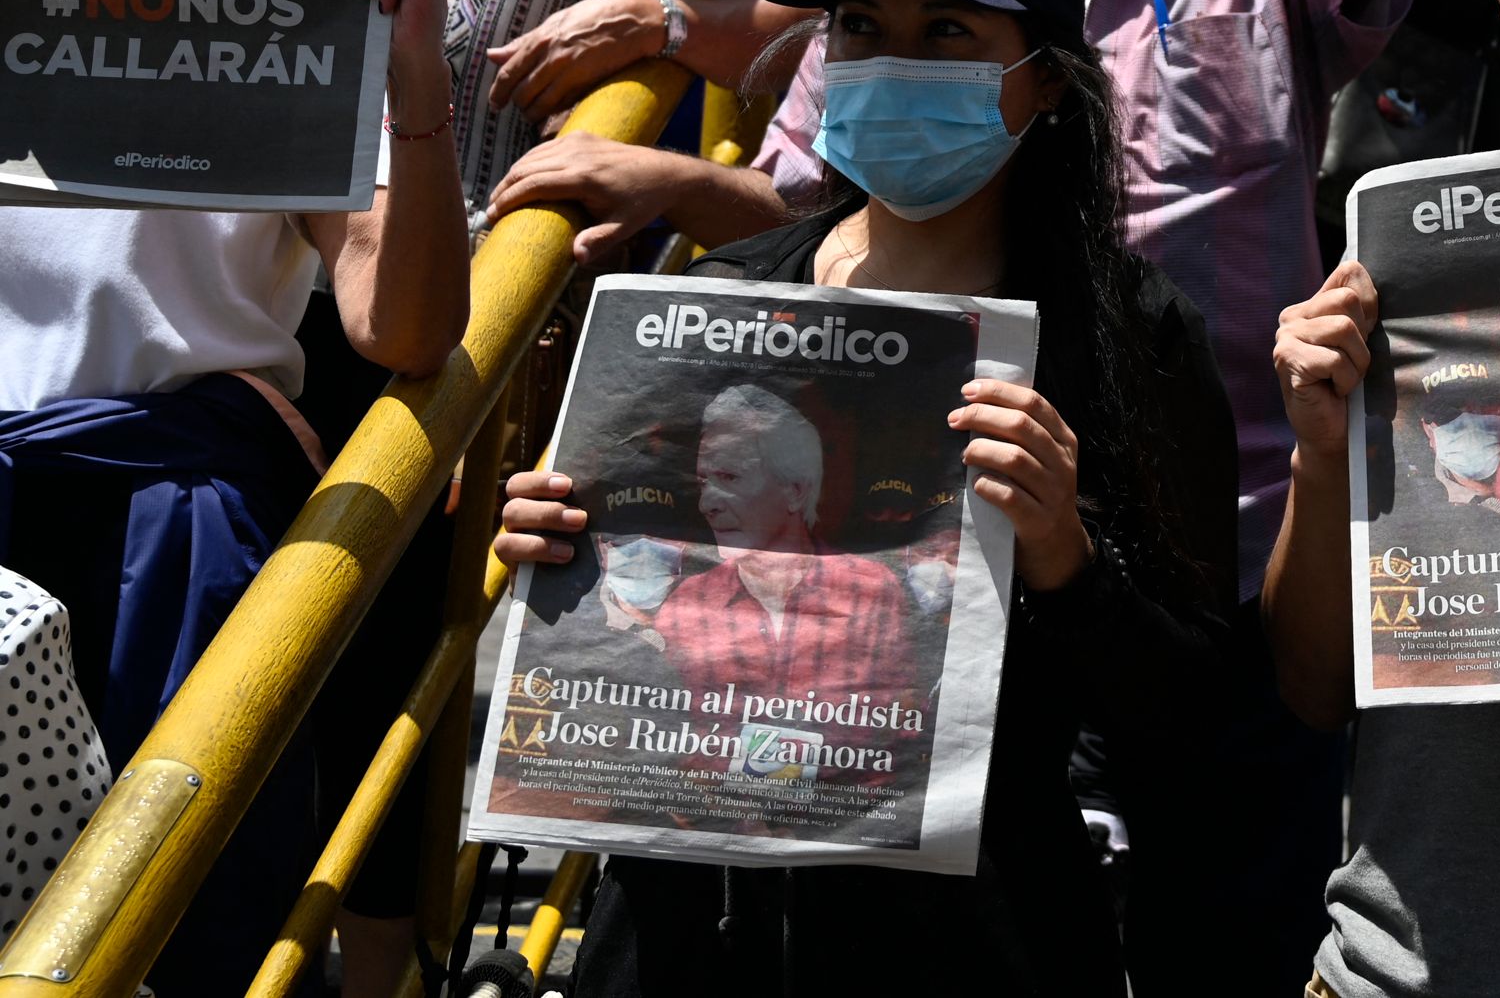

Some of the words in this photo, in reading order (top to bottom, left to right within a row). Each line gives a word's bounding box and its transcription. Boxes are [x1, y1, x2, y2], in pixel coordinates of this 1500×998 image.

[4, 31, 334, 86] CALLARÁN
[1421, 362, 1489, 393] POLICIA
[606, 486, 674, 511] POLICIA
[1407, 585, 1485, 618] Jose
[1393, 629, 1447, 638] Integrantes
[1450, 638, 1494, 648] presidente
[1432, 651, 1474, 660] periodista
[1455, 661, 1491, 673] personal
[523, 666, 692, 711] Capturan
[700, 683, 734, 715] al
[743, 689, 923, 732] periodista
[537, 711, 618, 747] Jose
[626, 718, 742, 760] Rubén
[749, 728, 893, 773] Zamora
[518, 753, 572, 765] Integrantes
[574, 758, 588, 767] del
[590, 760, 640, 772] Ministerio
[642, 764, 677, 775] Público
[687, 768, 698, 777] de
[700, 770, 709, 778] la
[711, 771, 743, 781] Policía
[745, 774, 787, 785] Nacional
[788, 778, 811, 787] Civil
[813, 780, 855, 791] allanaron
[856, 784, 869, 793] las
[870, 786, 904, 796] oficinas
[572, 797, 610, 806] personal
[612, 799, 625, 807] del
[627, 801, 654, 810] medio
[655, 804, 707, 815] permanecía
[709, 808, 745, 818] retenido
[759, 812, 771, 821] las
[773, 814, 810, 824] oficinas.
